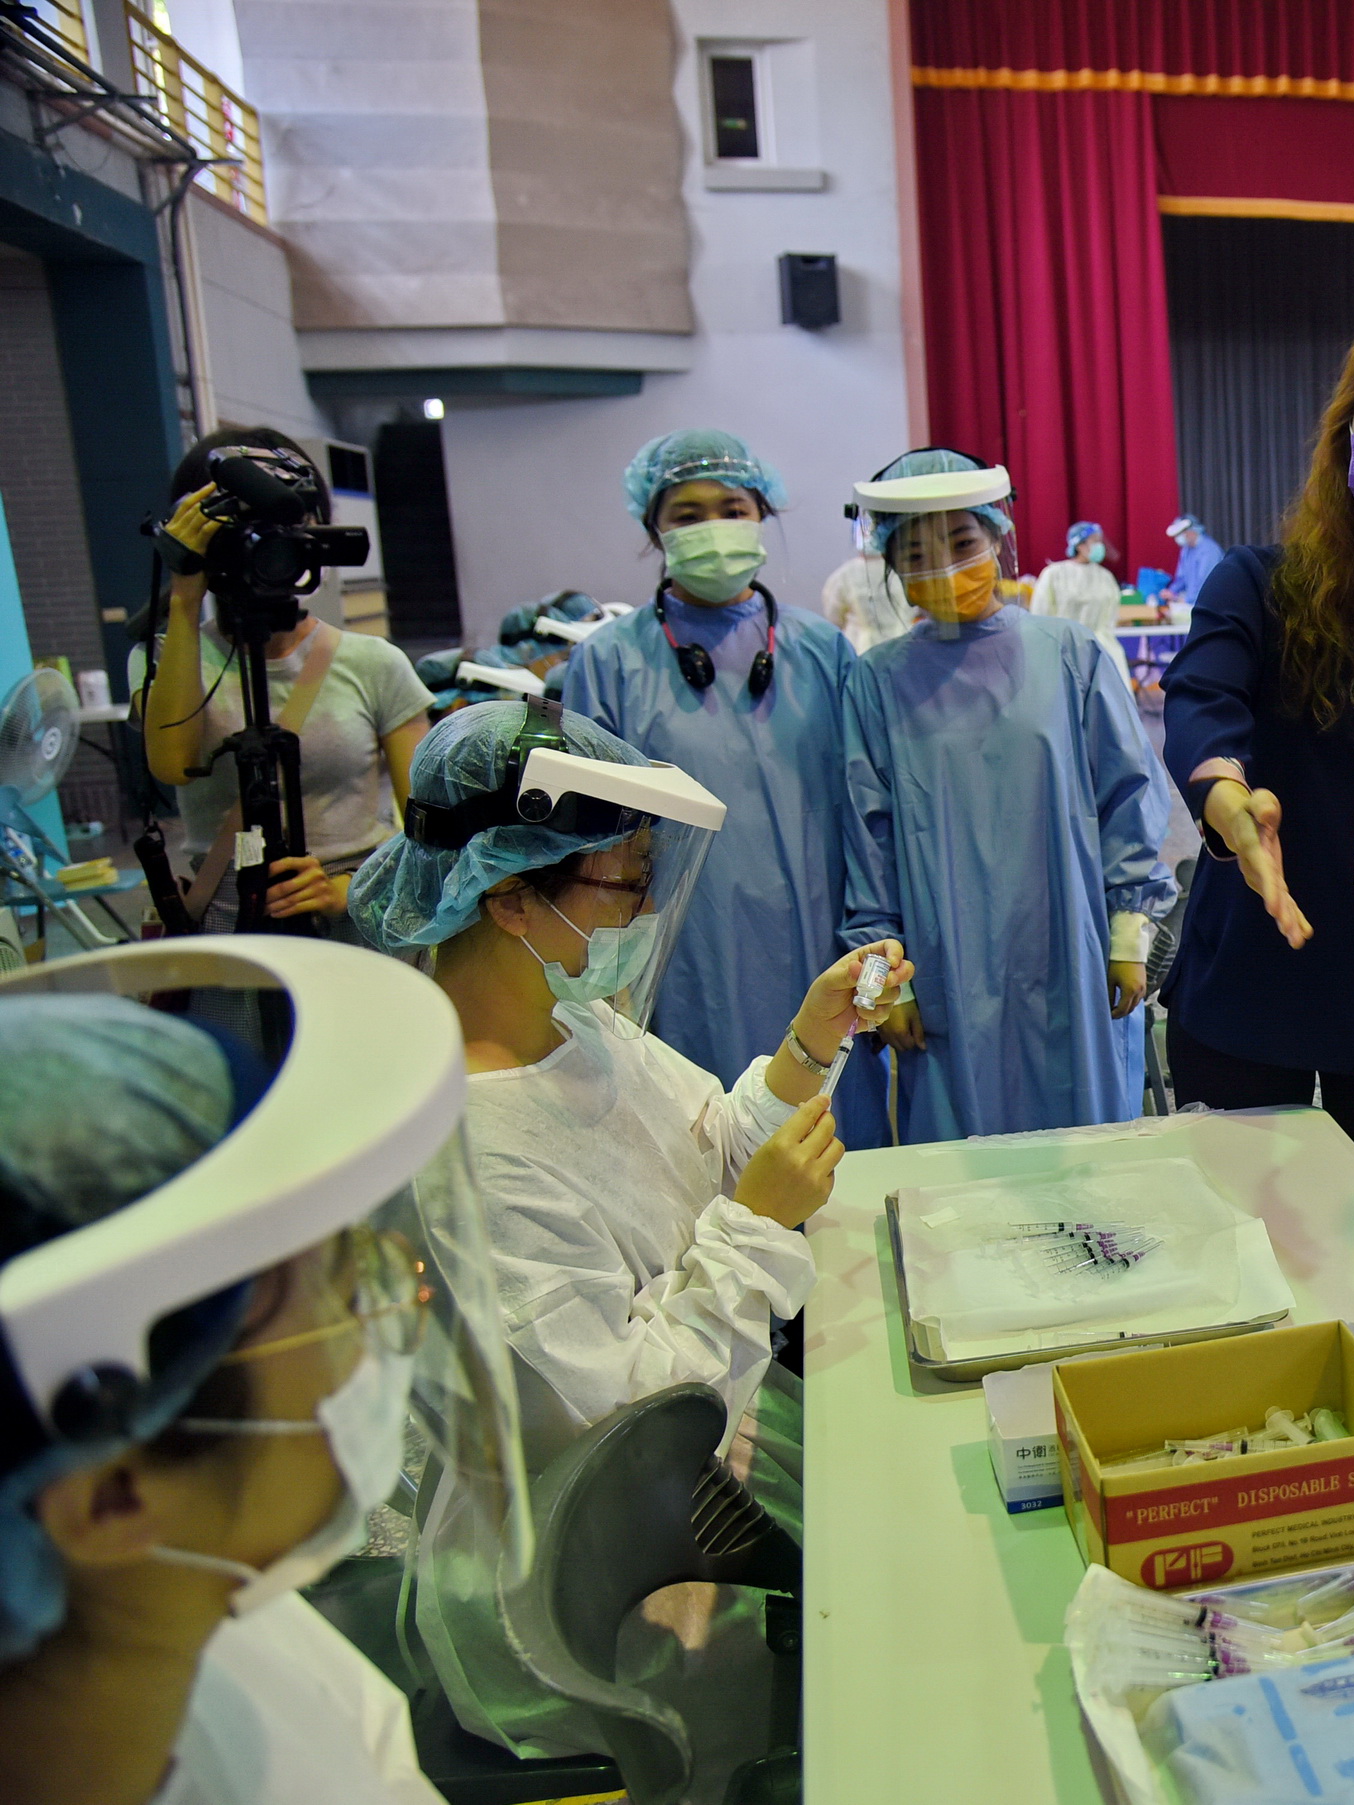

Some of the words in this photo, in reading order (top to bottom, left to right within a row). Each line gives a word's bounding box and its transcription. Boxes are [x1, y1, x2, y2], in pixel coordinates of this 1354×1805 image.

[1021, 1501, 1042, 1510] 3032
[1126, 1496, 1219, 1525] "PERFECT"
[1237, 1475, 1340, 1507] DISPOSABLE
[1251, 1526, 1284, 1538] PERFECT
[1286, 1520, 1318, 1531] MEDICAL
